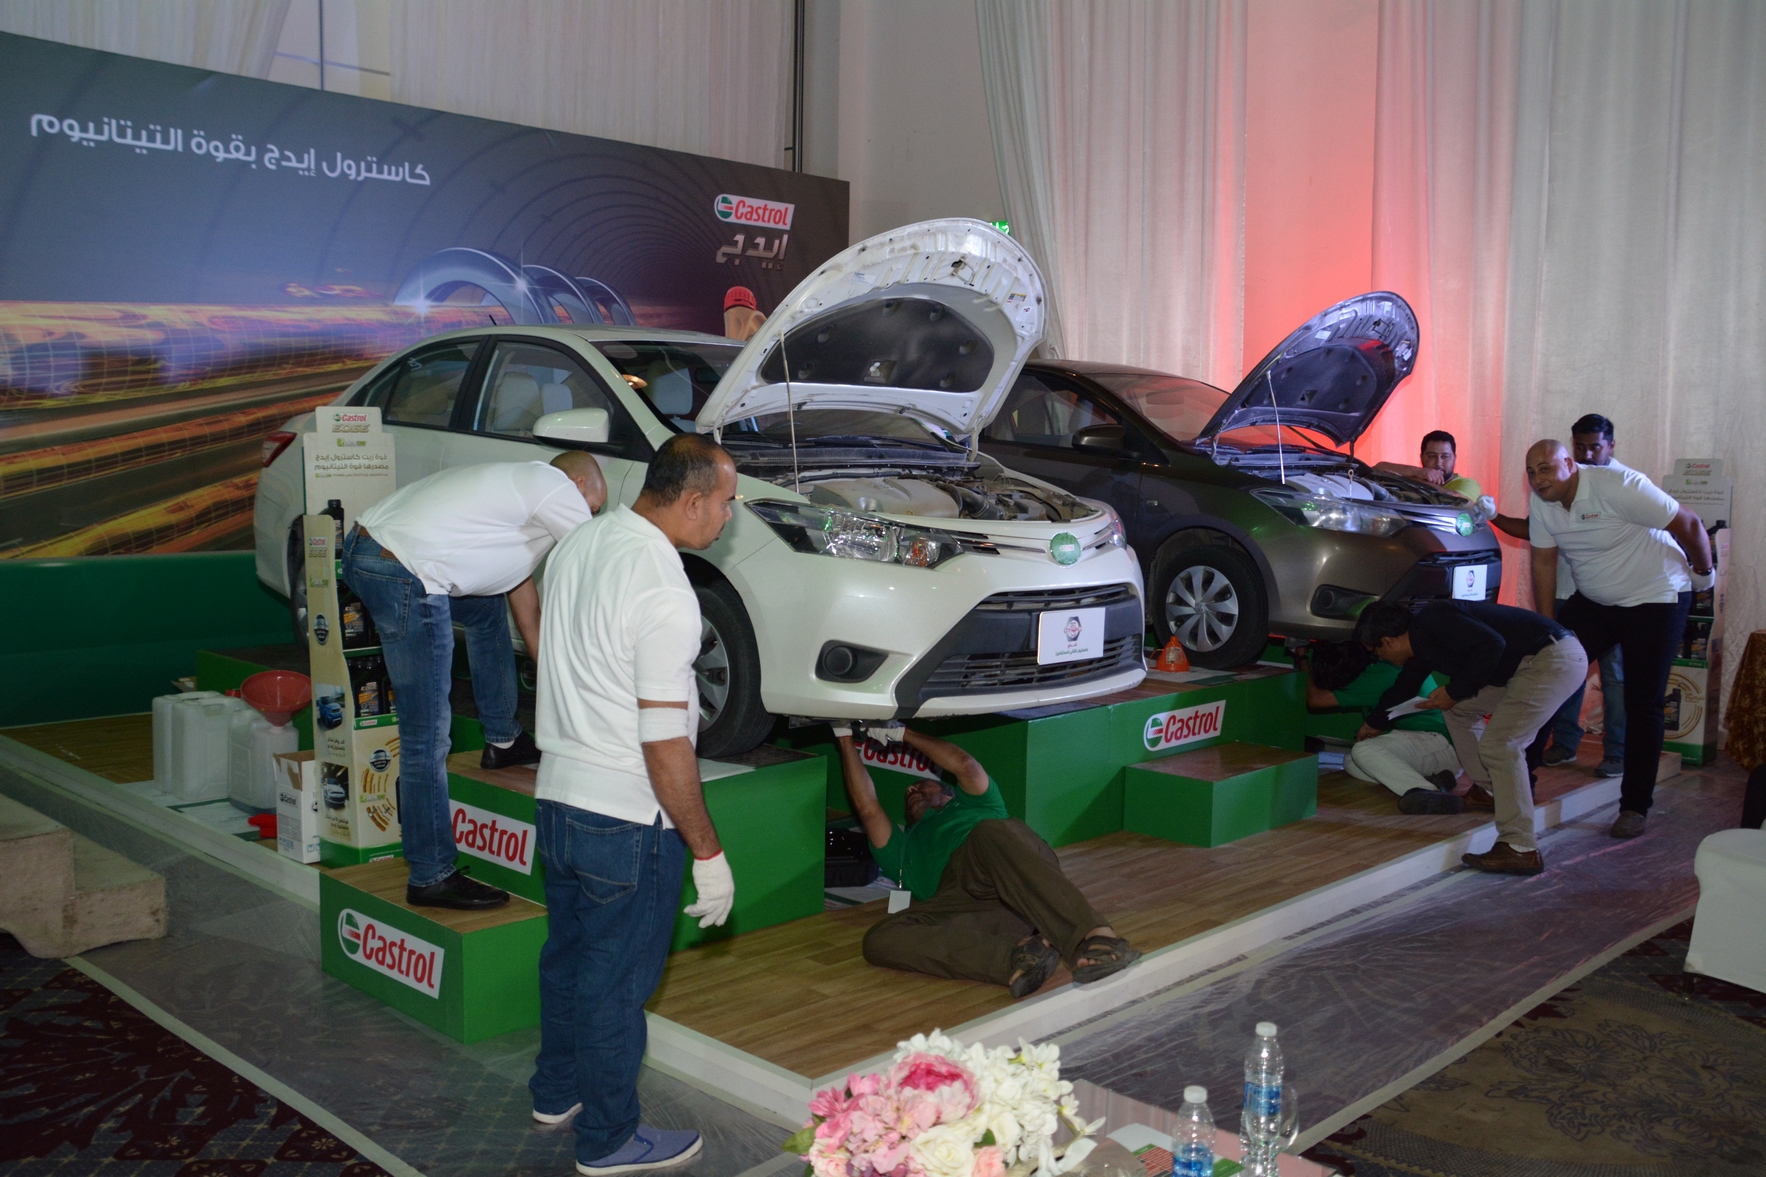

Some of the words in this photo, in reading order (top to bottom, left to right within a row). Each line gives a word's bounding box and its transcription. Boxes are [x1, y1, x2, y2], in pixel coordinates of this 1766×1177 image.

[30, 112, 184, 155] التيتانيوم
[191, 129, 257, 169] بقوة
[263, 143, 317, 177] إيدج
[322, 151, 431, 187] كاسترول
[734, 199, 789, 226] Castrol
[332, 423, 371, 433] EDGE
[342, 413, 367, 422] Castrol
[1164, 705, 1220, 744] Castrol
[452, 807, 529, 867] Castrol
[362, 923, 436, 990] Castrol
